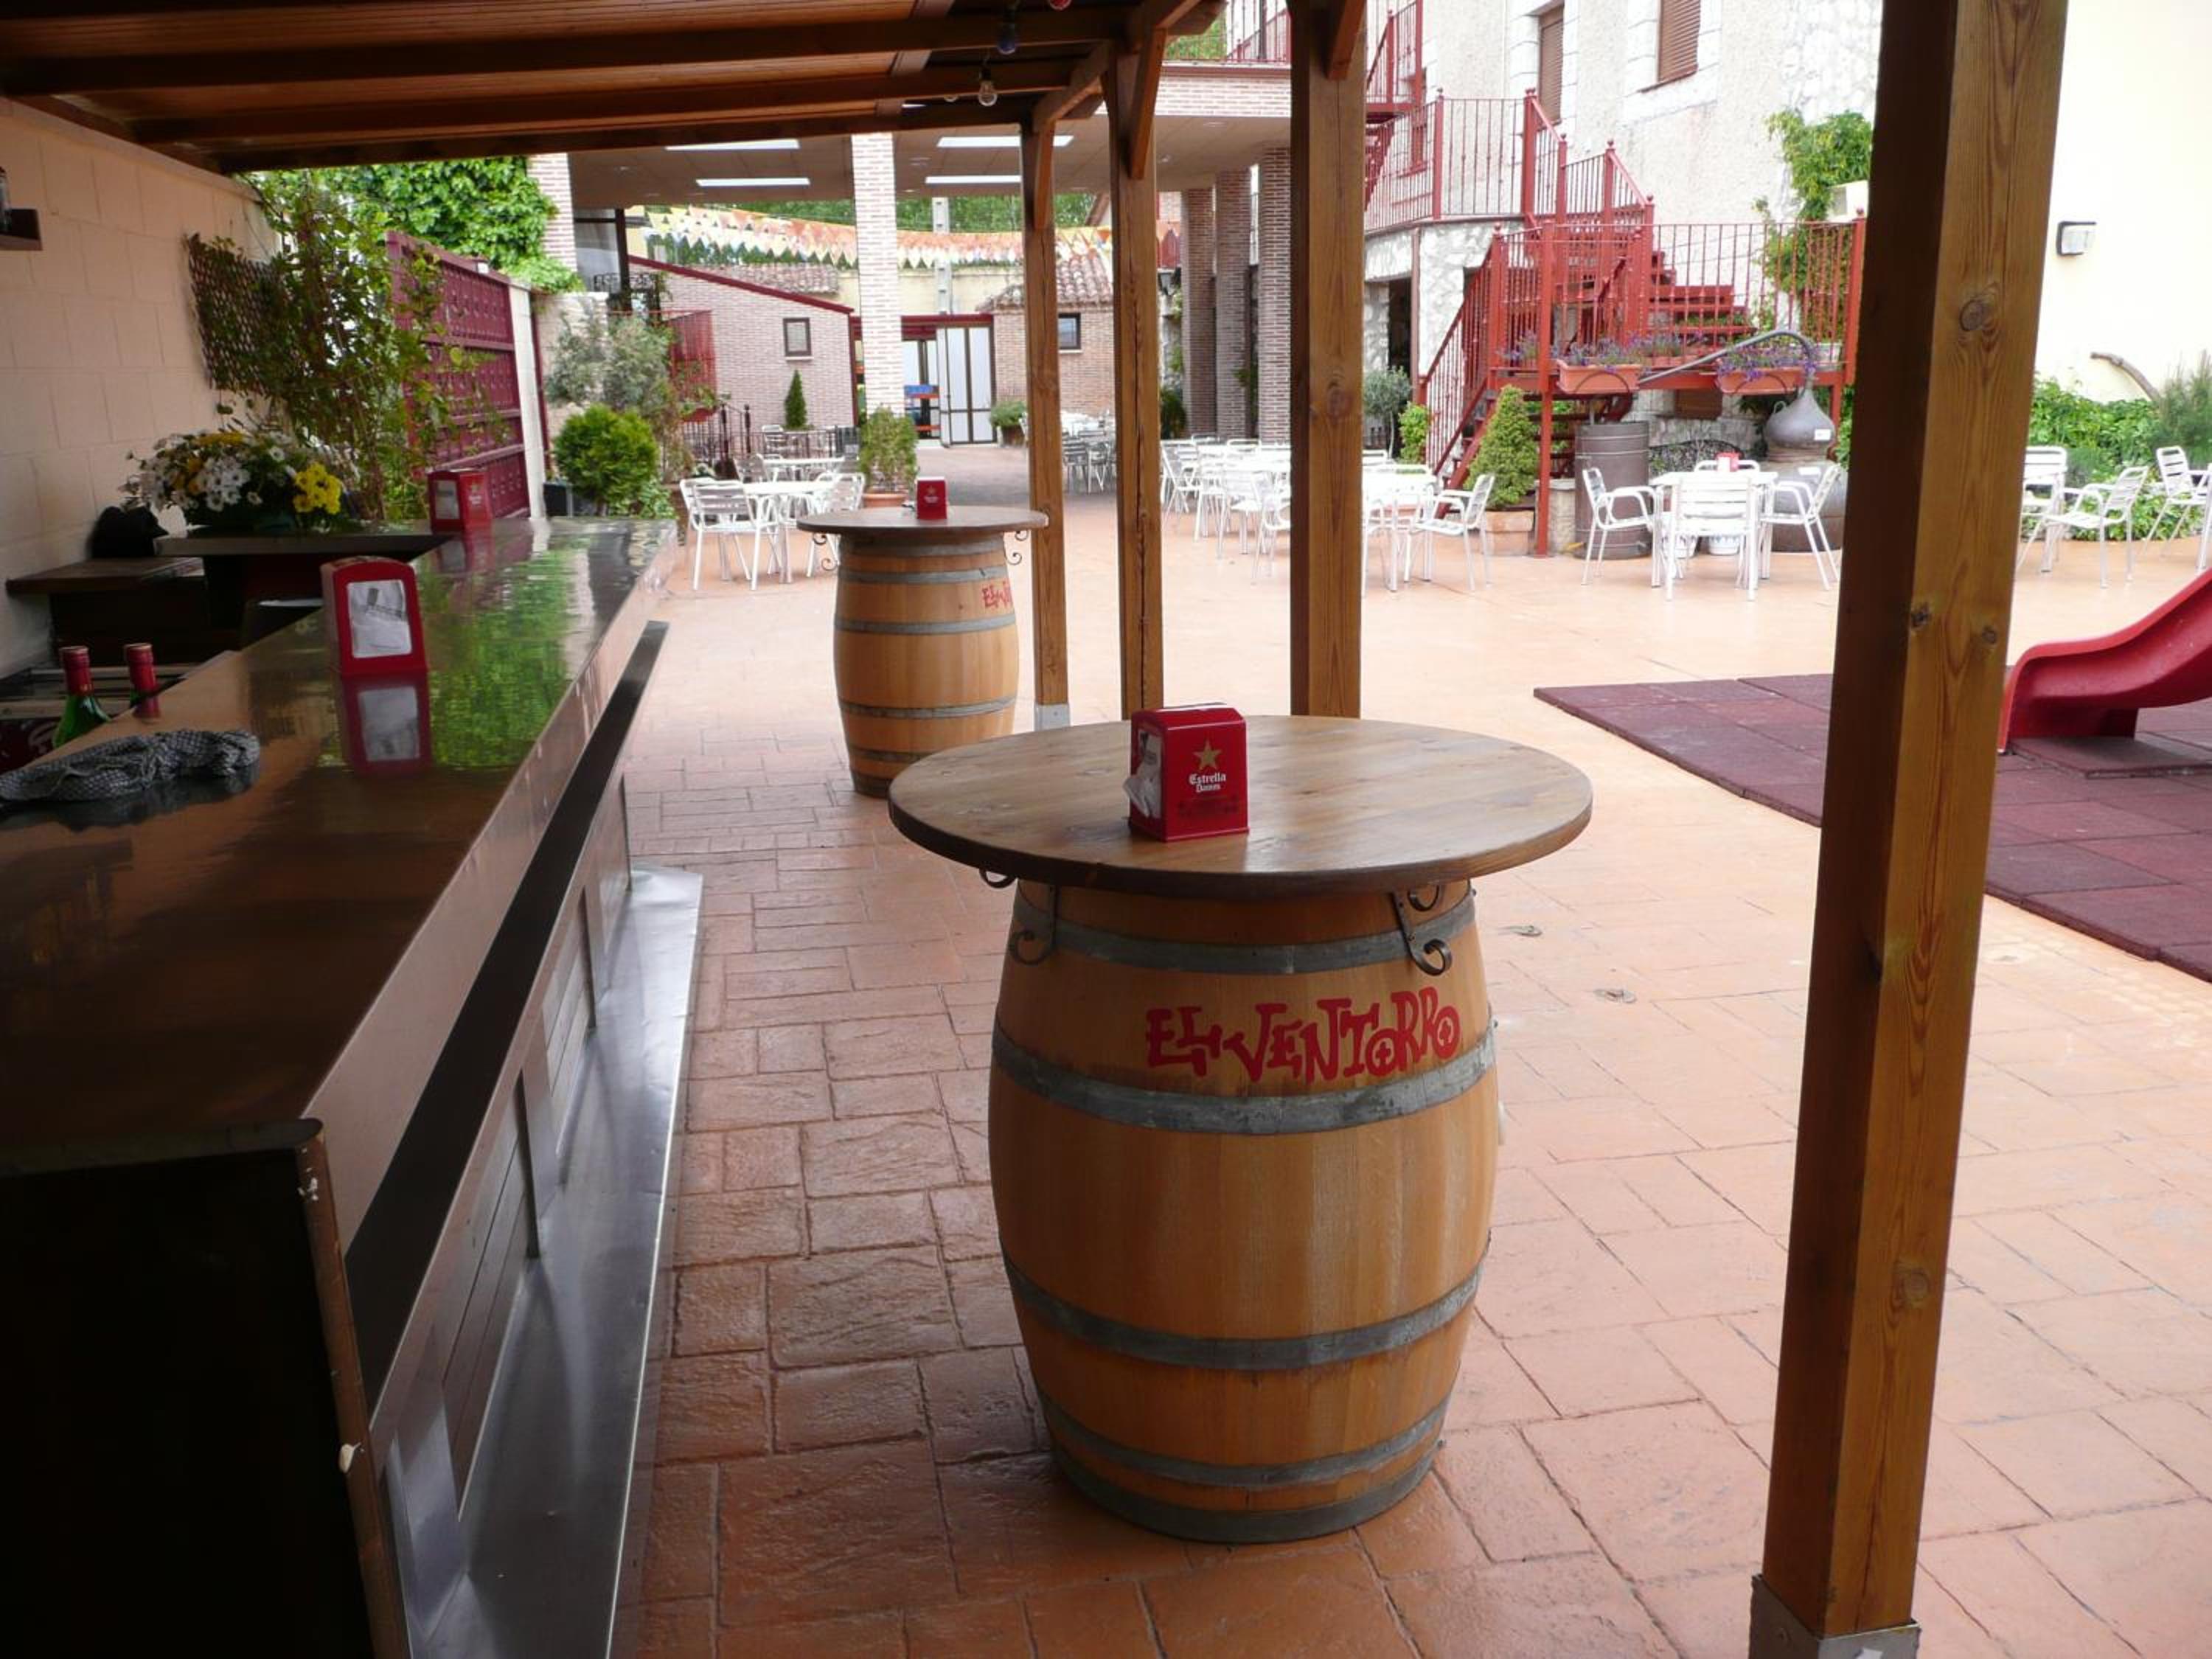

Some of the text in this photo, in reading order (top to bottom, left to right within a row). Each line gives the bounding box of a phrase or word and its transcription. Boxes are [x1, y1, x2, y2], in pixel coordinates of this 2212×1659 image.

[1189, 772, 1226, 785] Estrella
[1147, 987, 1461, 1082] EL VENTORRO
